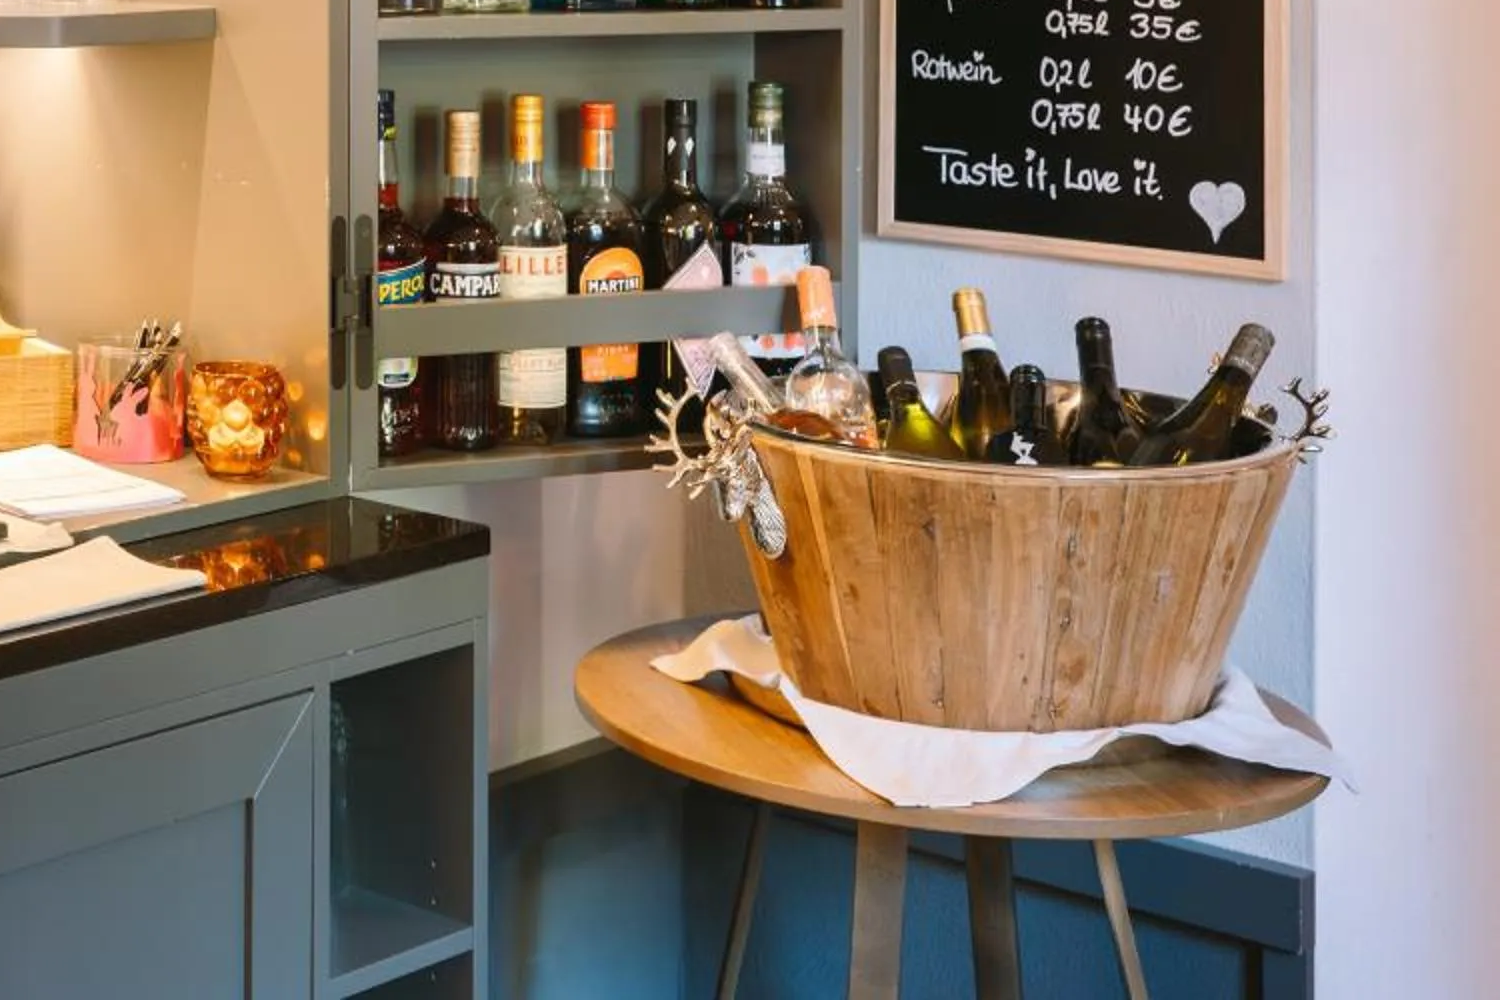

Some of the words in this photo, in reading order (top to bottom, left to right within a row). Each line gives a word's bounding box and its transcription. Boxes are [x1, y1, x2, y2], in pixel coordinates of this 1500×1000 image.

[1130, 13, 1202, 41] 35€
[911, 50, 1002, 84] Rotwein
[1125, 58, 1183, 92] 10€
[922, 145, 1019, 187] Taste
[1025, 147, 1057, 200] it,
[1064, 158, 1121, 193] Love
[502, 253, 564, 276] LILLE
[430, 273, 500, 298] CAMPAR
